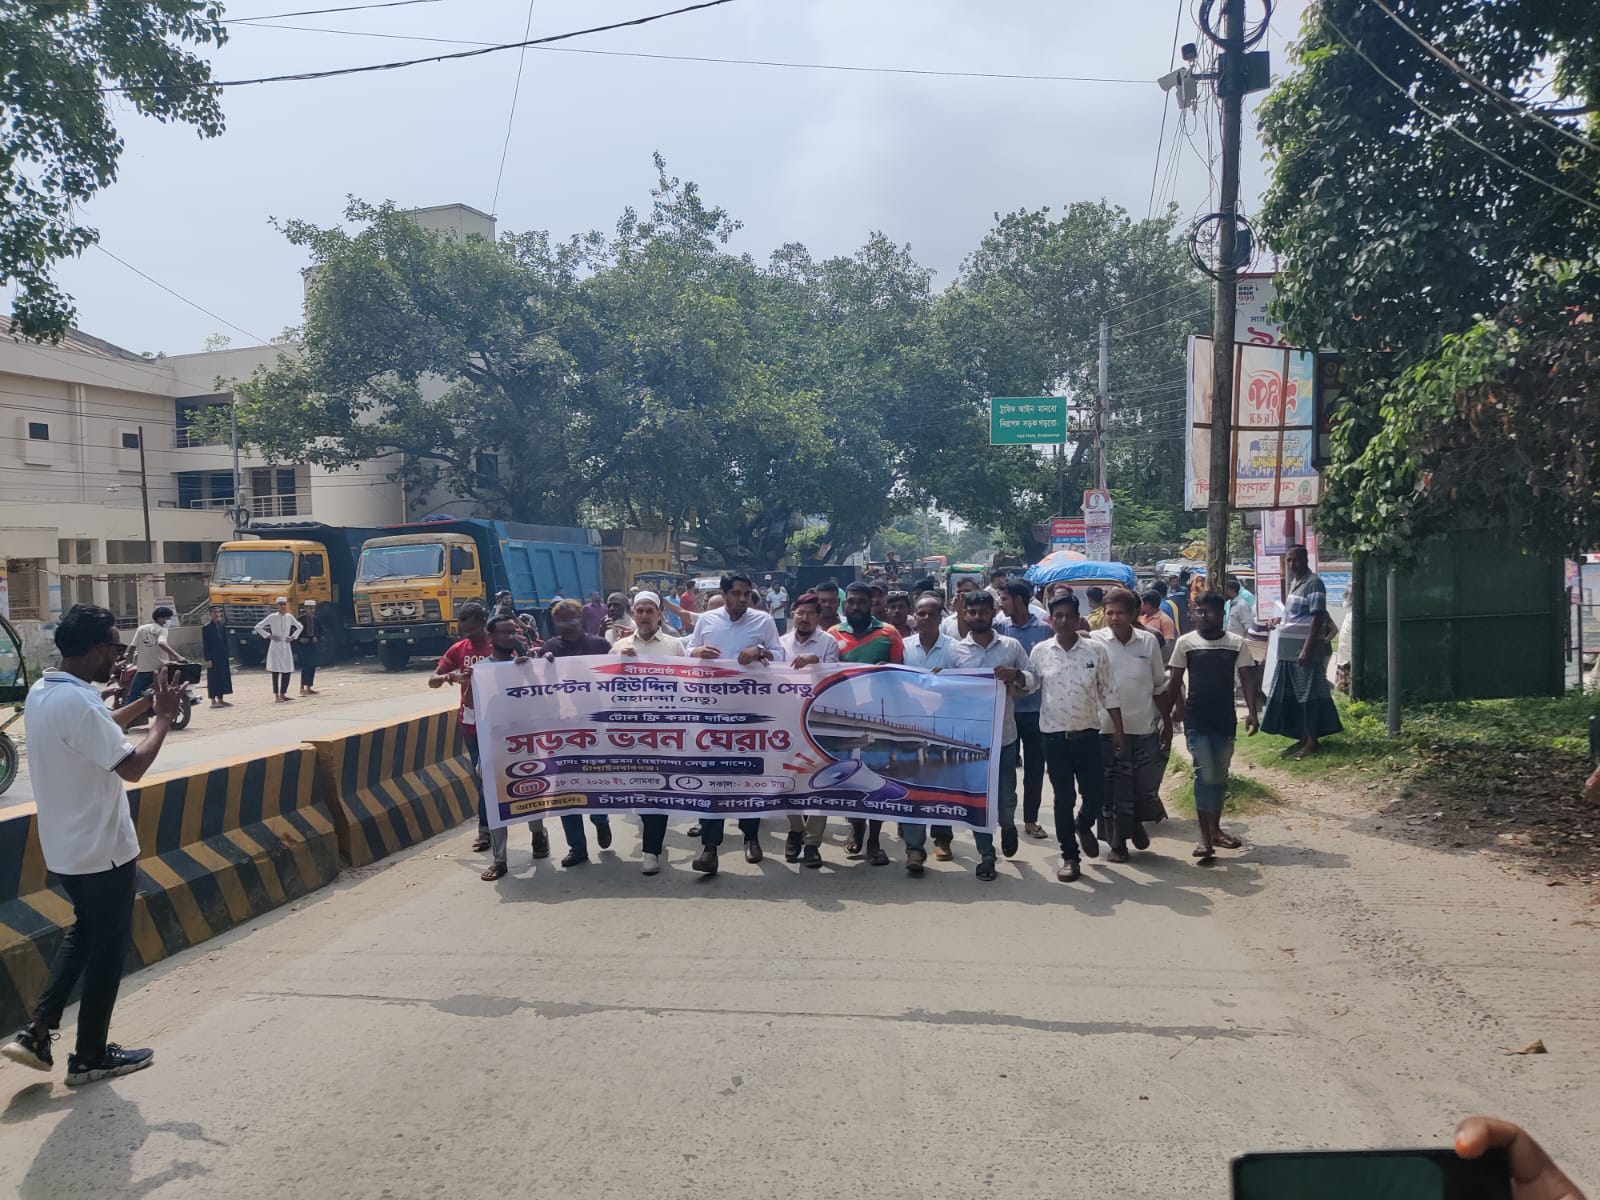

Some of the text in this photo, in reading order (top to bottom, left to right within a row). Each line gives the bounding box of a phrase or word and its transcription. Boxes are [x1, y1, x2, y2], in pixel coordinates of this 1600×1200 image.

[1023, 419, 1037, 428] সড়ক
[623, 666, 716, 678] বীরশ্রেষ্ঠ শহীদ
[505, 676, 815, 699] ক্যাপ্টেন মহিউদ্দিন জাহাঙ্গীর সেতু
[611, 694, 718, 705] (মহানন্দা সেতু)
[608, 713, 747, 722] টোল ফ্রি করার দাবিতে
[505, 728, 791, 755] সড়ক ভবন ঘেরাও
[629, 777, 661, 786] সোমবার
[597, 793, 712, 808] চাঁপাইনবাবগঞ্জ
[717, 796, 782, 808] নাগরিক
[788, 796, 857, 808] অধিকার
[863, 799, 914, 813] আদায়
[919, 804, 969, 818] কমিটি
